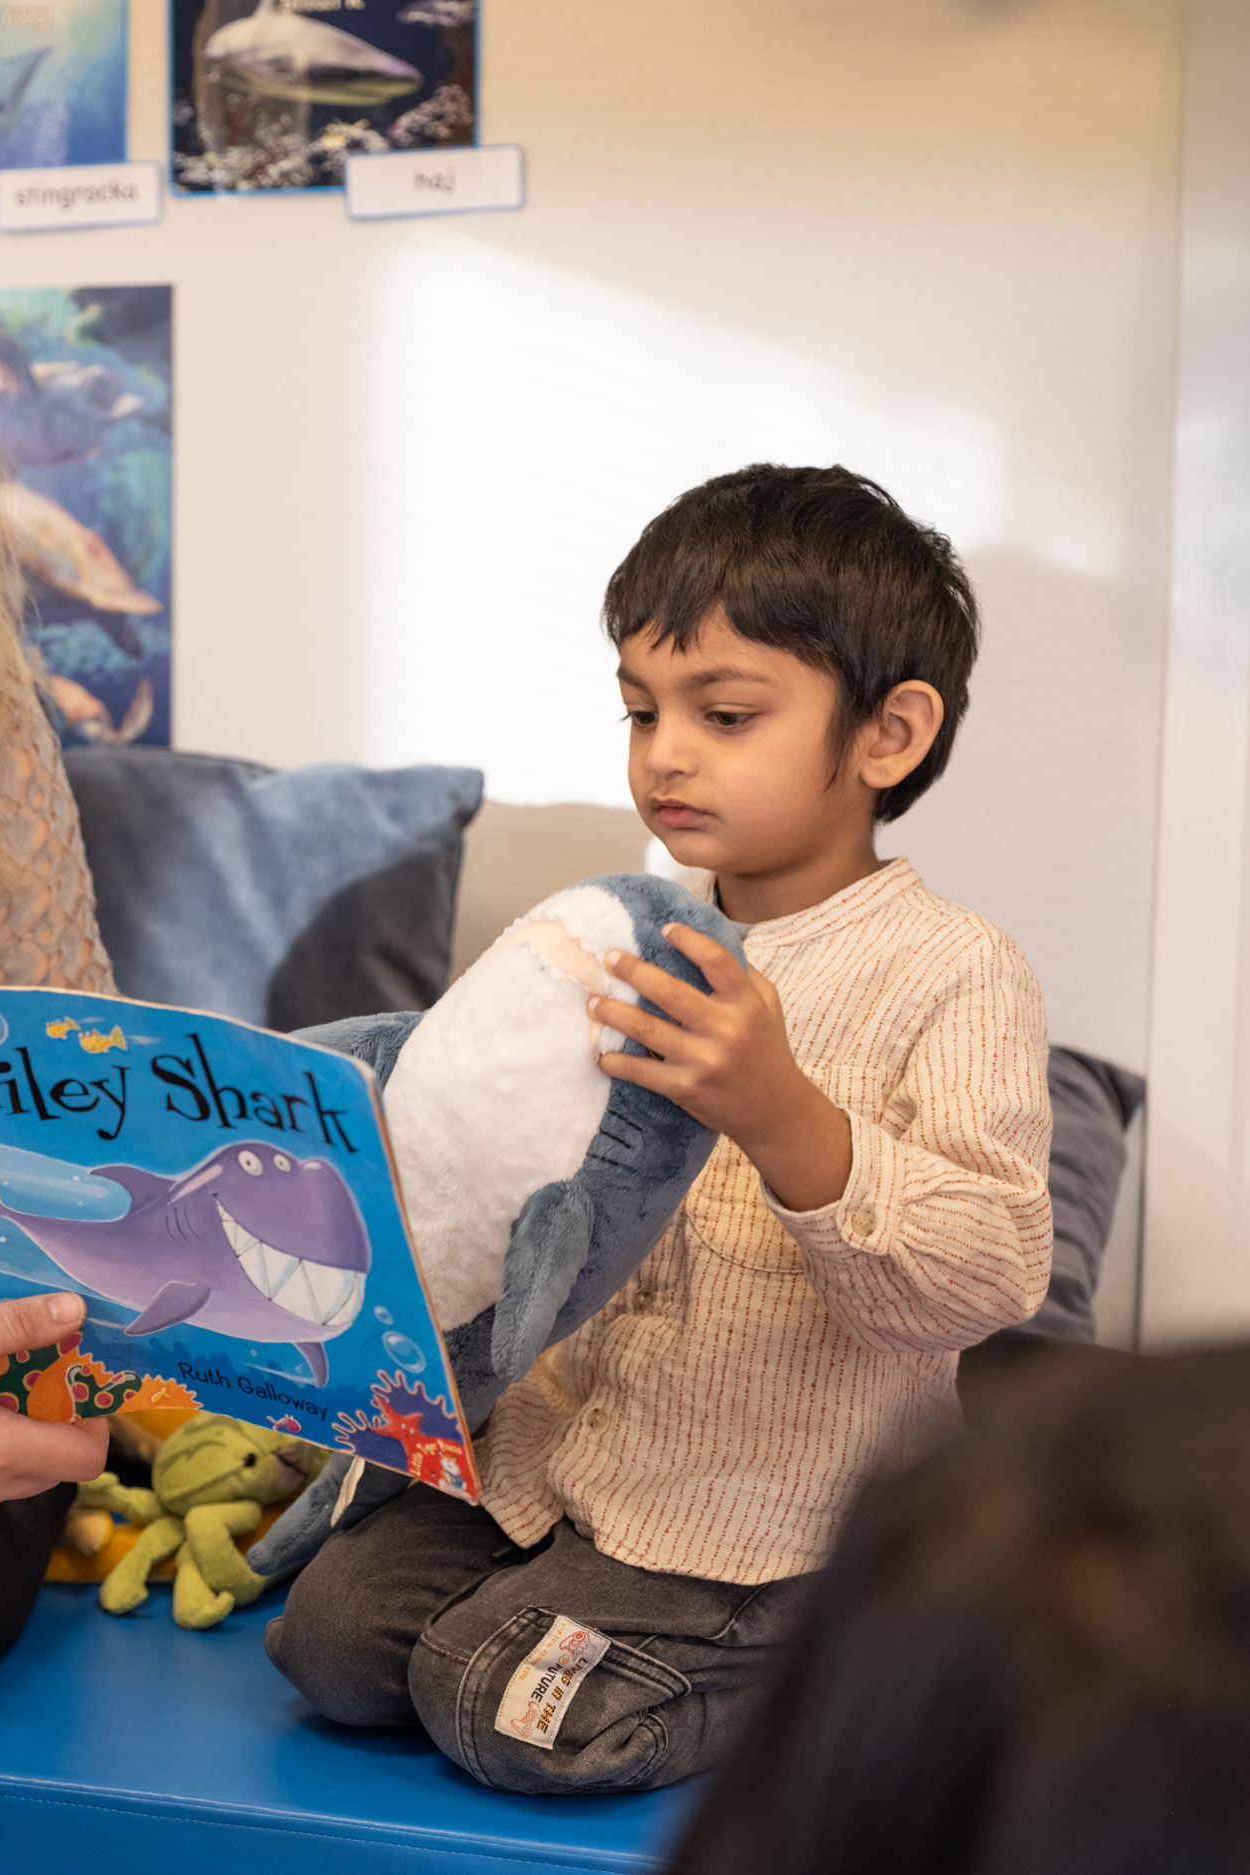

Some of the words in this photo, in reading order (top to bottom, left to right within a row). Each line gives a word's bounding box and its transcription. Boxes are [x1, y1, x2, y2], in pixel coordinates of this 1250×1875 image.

[14, 179, 139, 213] stingrocka
[151, 1032, 359, 1153] Shark
[178, 1362, 231, 1389] Ruth
[238, 1376, 328, 1422] Galloway
[547, 1622, 567, 1649] VIRTUAL
[531, 1662, 563, 1702] FUTURE
[537, 1703, 556, 1734] THE
